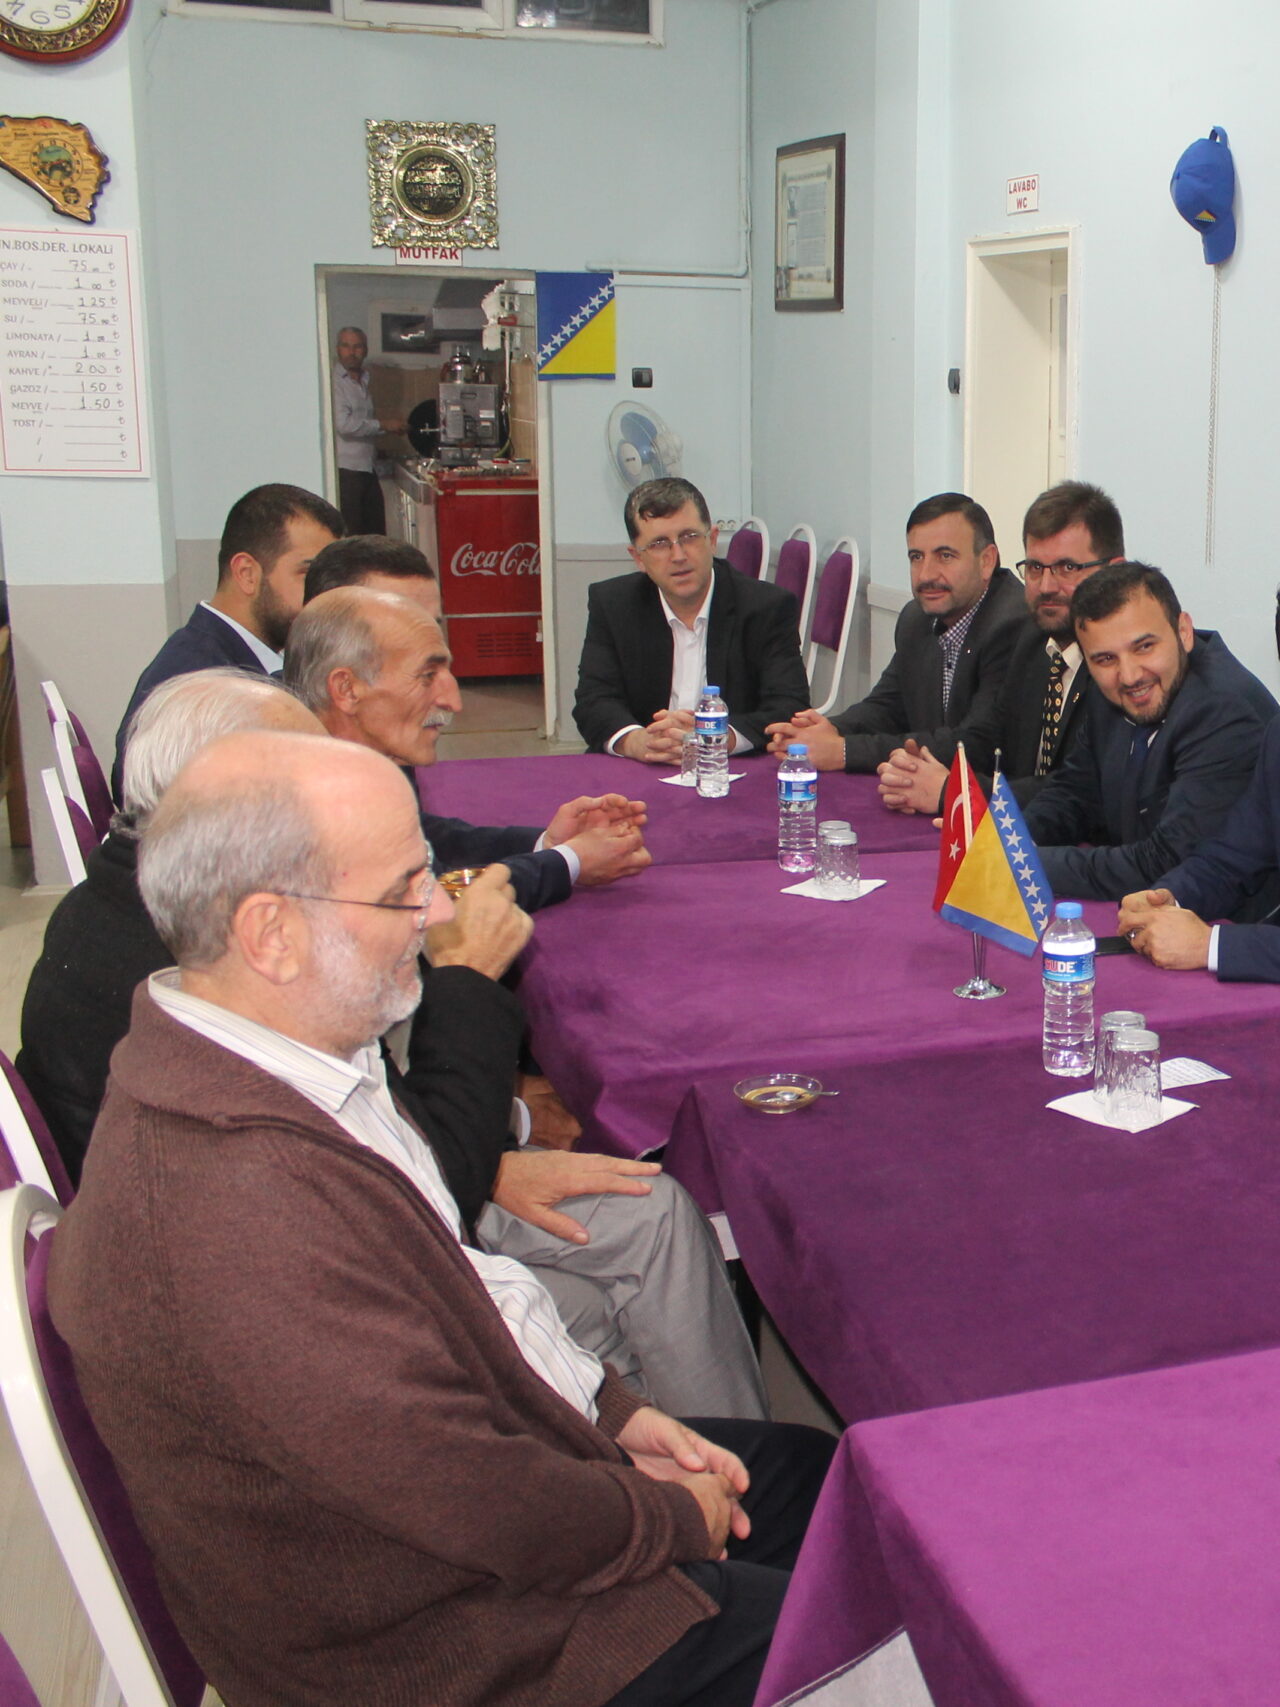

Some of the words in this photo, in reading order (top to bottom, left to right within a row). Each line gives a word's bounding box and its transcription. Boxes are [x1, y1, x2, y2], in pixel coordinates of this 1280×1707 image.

[54, 5, 71, 19] 5
[30, 10, 50, 25] 6
[1008, 179, 1036, 194] LAVABO
[1016, 197, 1027, 209] WC
[399, 246, 459, 260] MUTFAK
[1, 280, 28, 288] SODA
[7, 350, 38, 358] AYRAN
[9, 368, 40, 376] KAHVE
[12, 402, 42, 410] MEYVE
[13, 419, 36, 427] TOST
